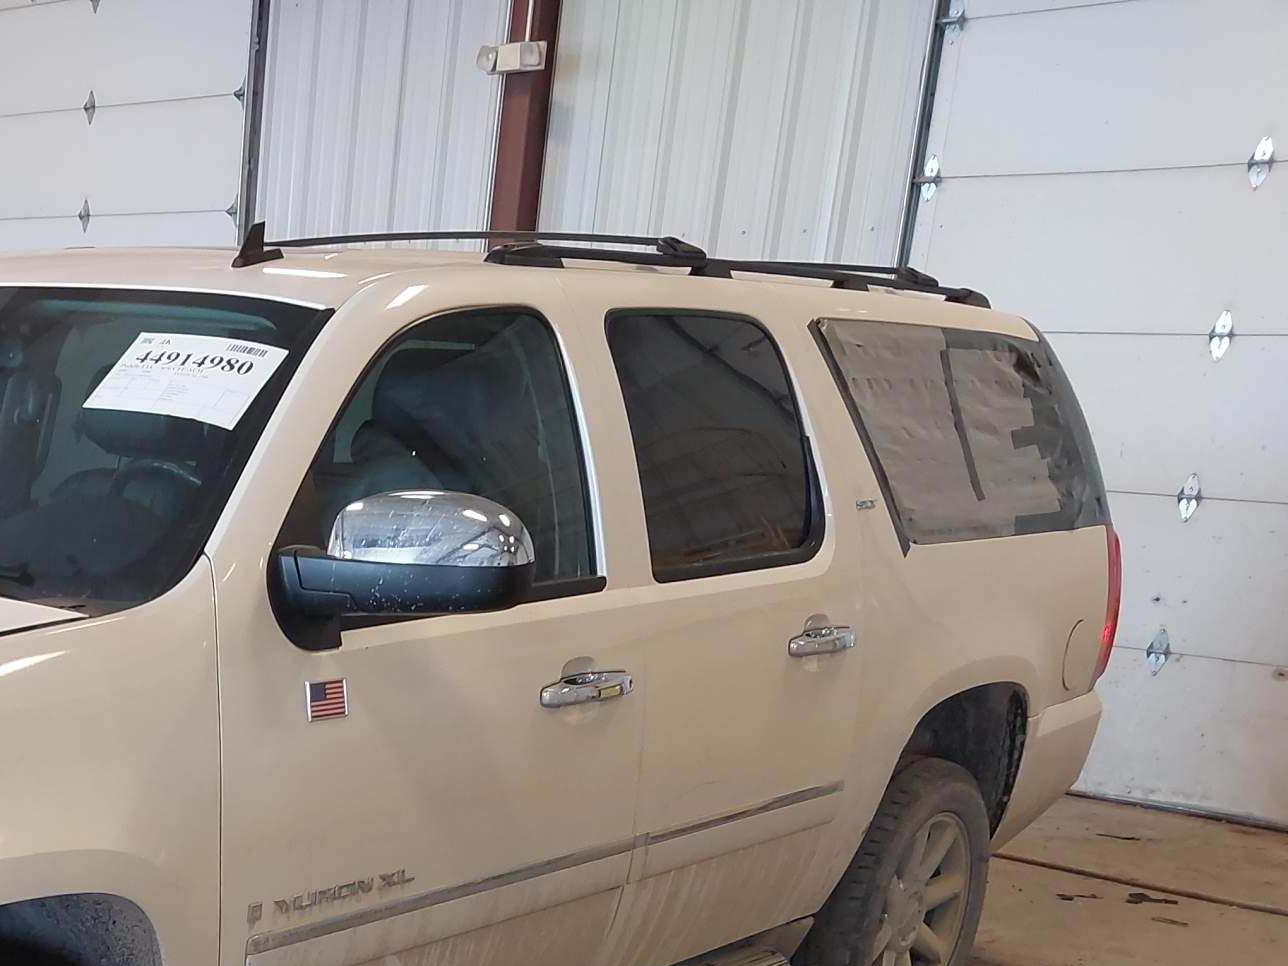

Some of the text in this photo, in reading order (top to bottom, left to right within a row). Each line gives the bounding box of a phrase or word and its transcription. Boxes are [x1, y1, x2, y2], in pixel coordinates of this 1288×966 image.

[136, 350, 254, 375] 44914980
[272, 869, 415, 913] YUKON XL
